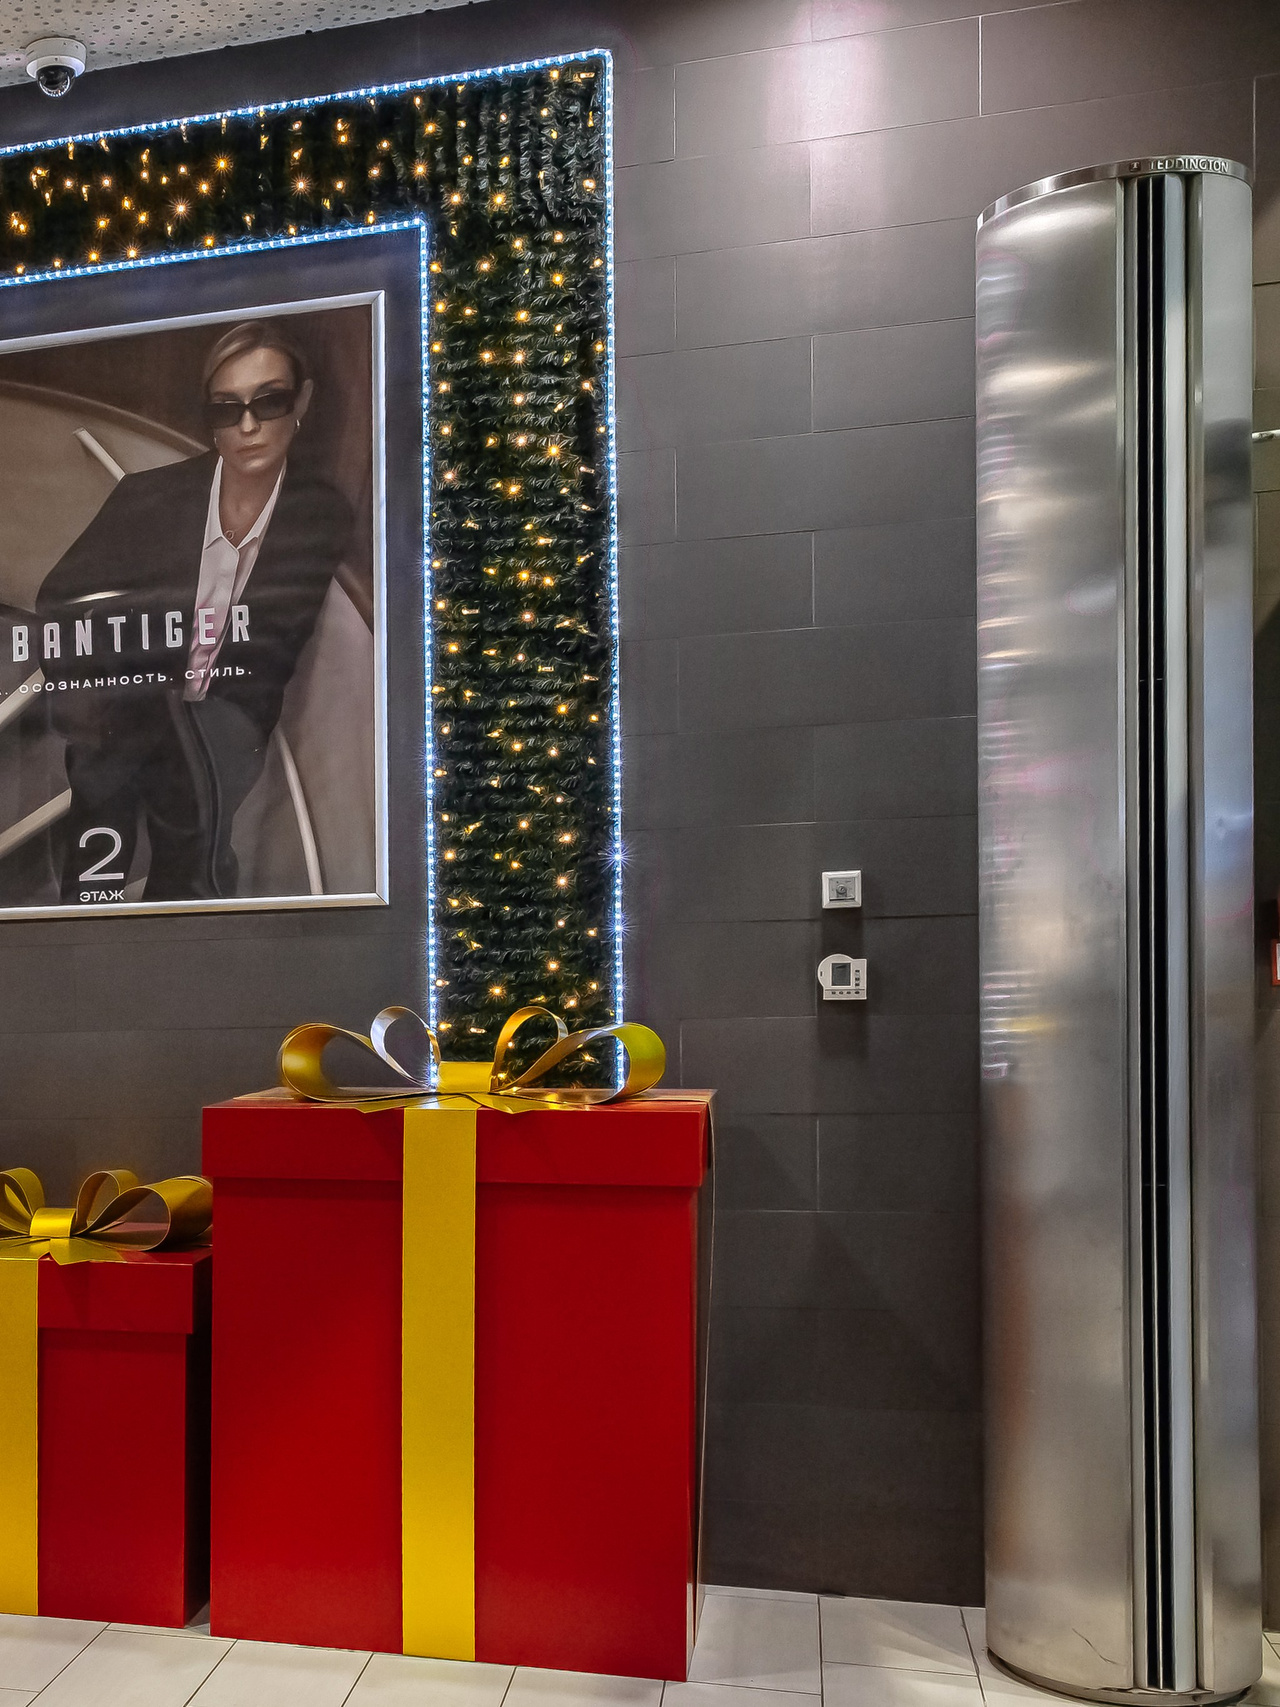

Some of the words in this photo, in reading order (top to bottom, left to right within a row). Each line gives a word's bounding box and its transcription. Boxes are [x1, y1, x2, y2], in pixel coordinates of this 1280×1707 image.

[1150, 157, 1229, 173] TEDDINGTON
[19, 673, 173, 694] ОСОЗНАННОСТЬ.
[184, 666, 252, 680] СТИЛЬ.
[78, 827, 124, 882] 2
[79, 889, 125, 902] ЭТАЖ
